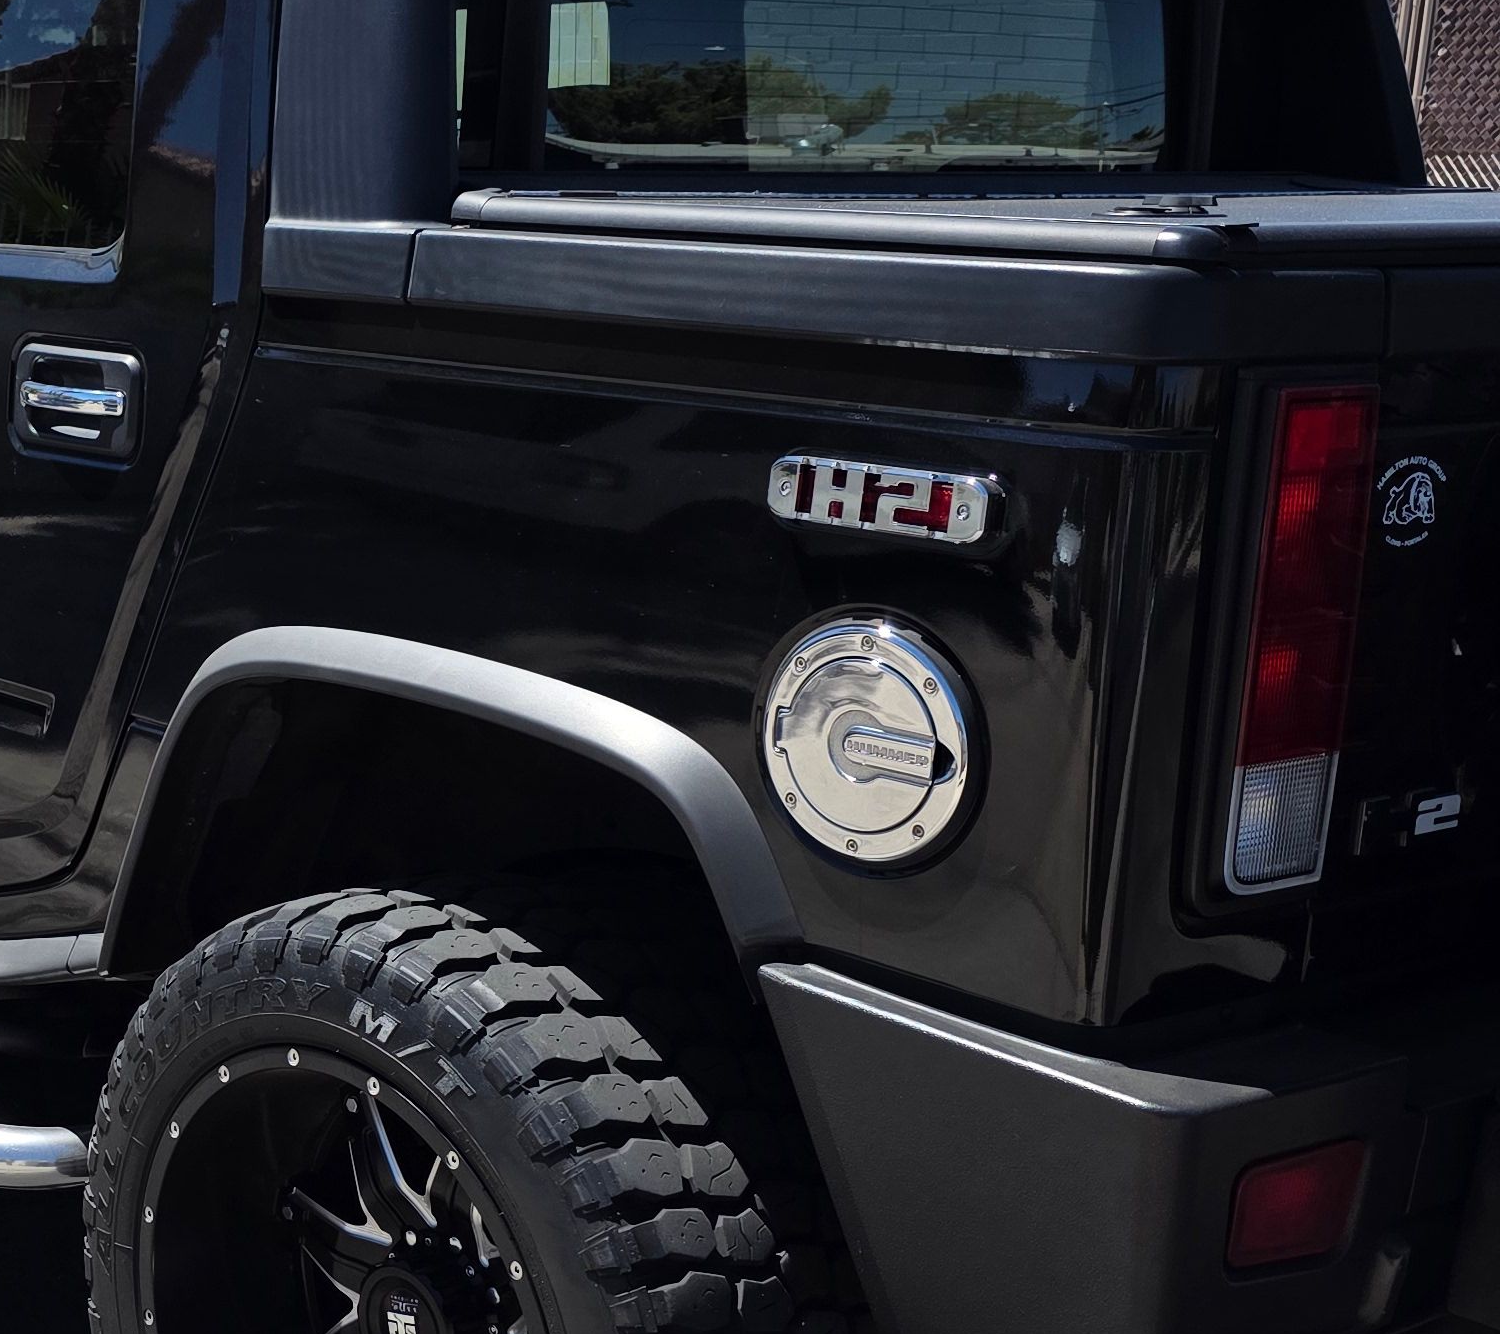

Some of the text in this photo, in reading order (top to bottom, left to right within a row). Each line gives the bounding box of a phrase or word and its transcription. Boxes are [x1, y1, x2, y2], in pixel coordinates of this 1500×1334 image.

[1410, 456, 1428, 465] AUTO
[1428, 460, 1447, 482] GROUP
[809, 460, 932, 536] H2
[846, 739, 930, 768] HUMMER
[119, 975, 331, 1131] COUNTRY
[347, 997, 477, 1098] M/T
